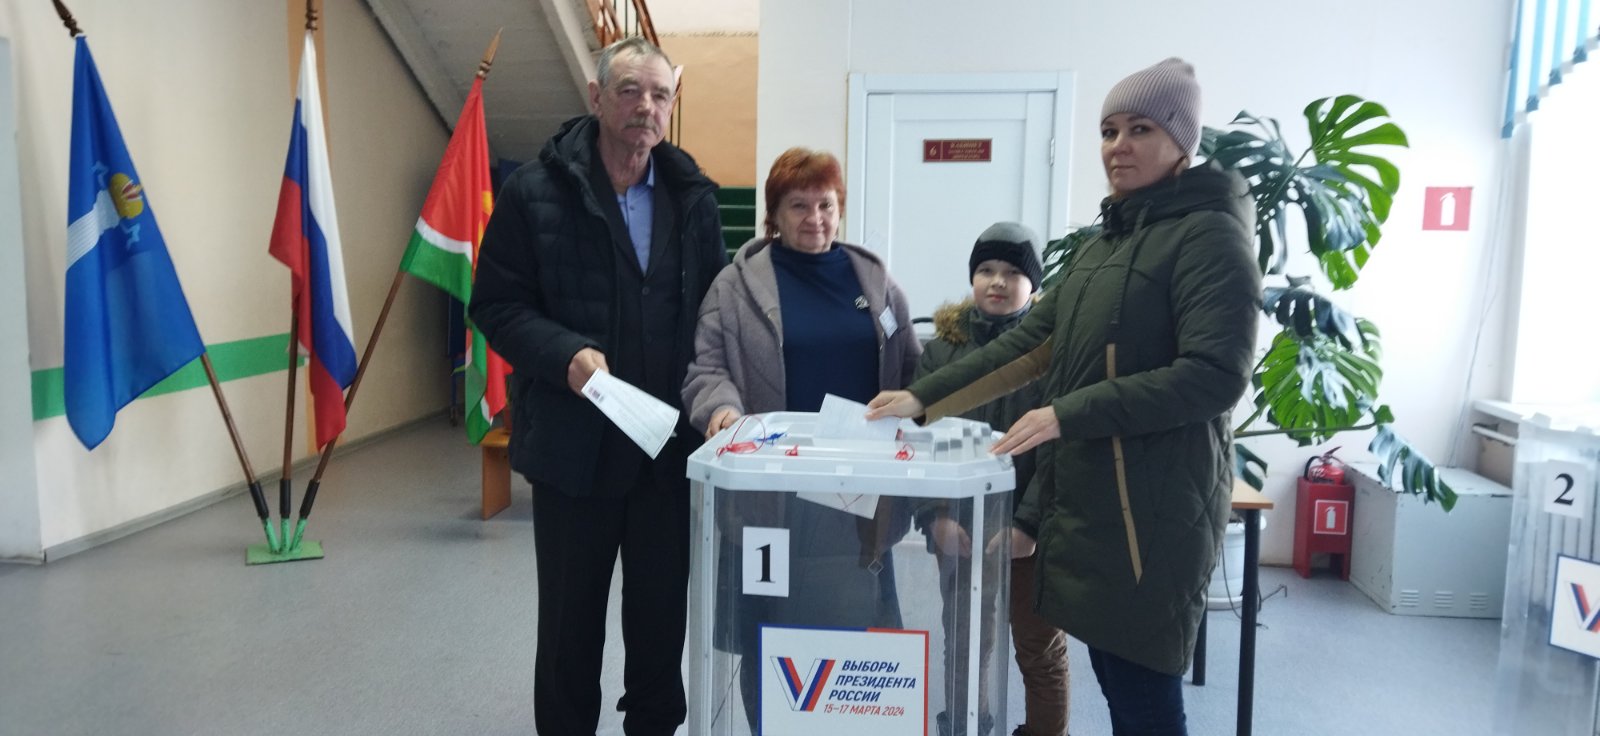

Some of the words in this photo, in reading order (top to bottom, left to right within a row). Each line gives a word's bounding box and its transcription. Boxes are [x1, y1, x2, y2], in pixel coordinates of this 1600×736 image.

[928, 144, 937, 157] 6
[1553, 473, 1575, 506] 2
[755, 543, 776, 584] 1
[842, 660, 900, 673] ВЫБОРЫ
[835, 675, 916, 689] ПРЕЗИДЕНТА
[828, 689, 881, 702] РОССИИ
[850, 706, 881, 715] МАРТА
[882, 707, 904, 716] 2024
